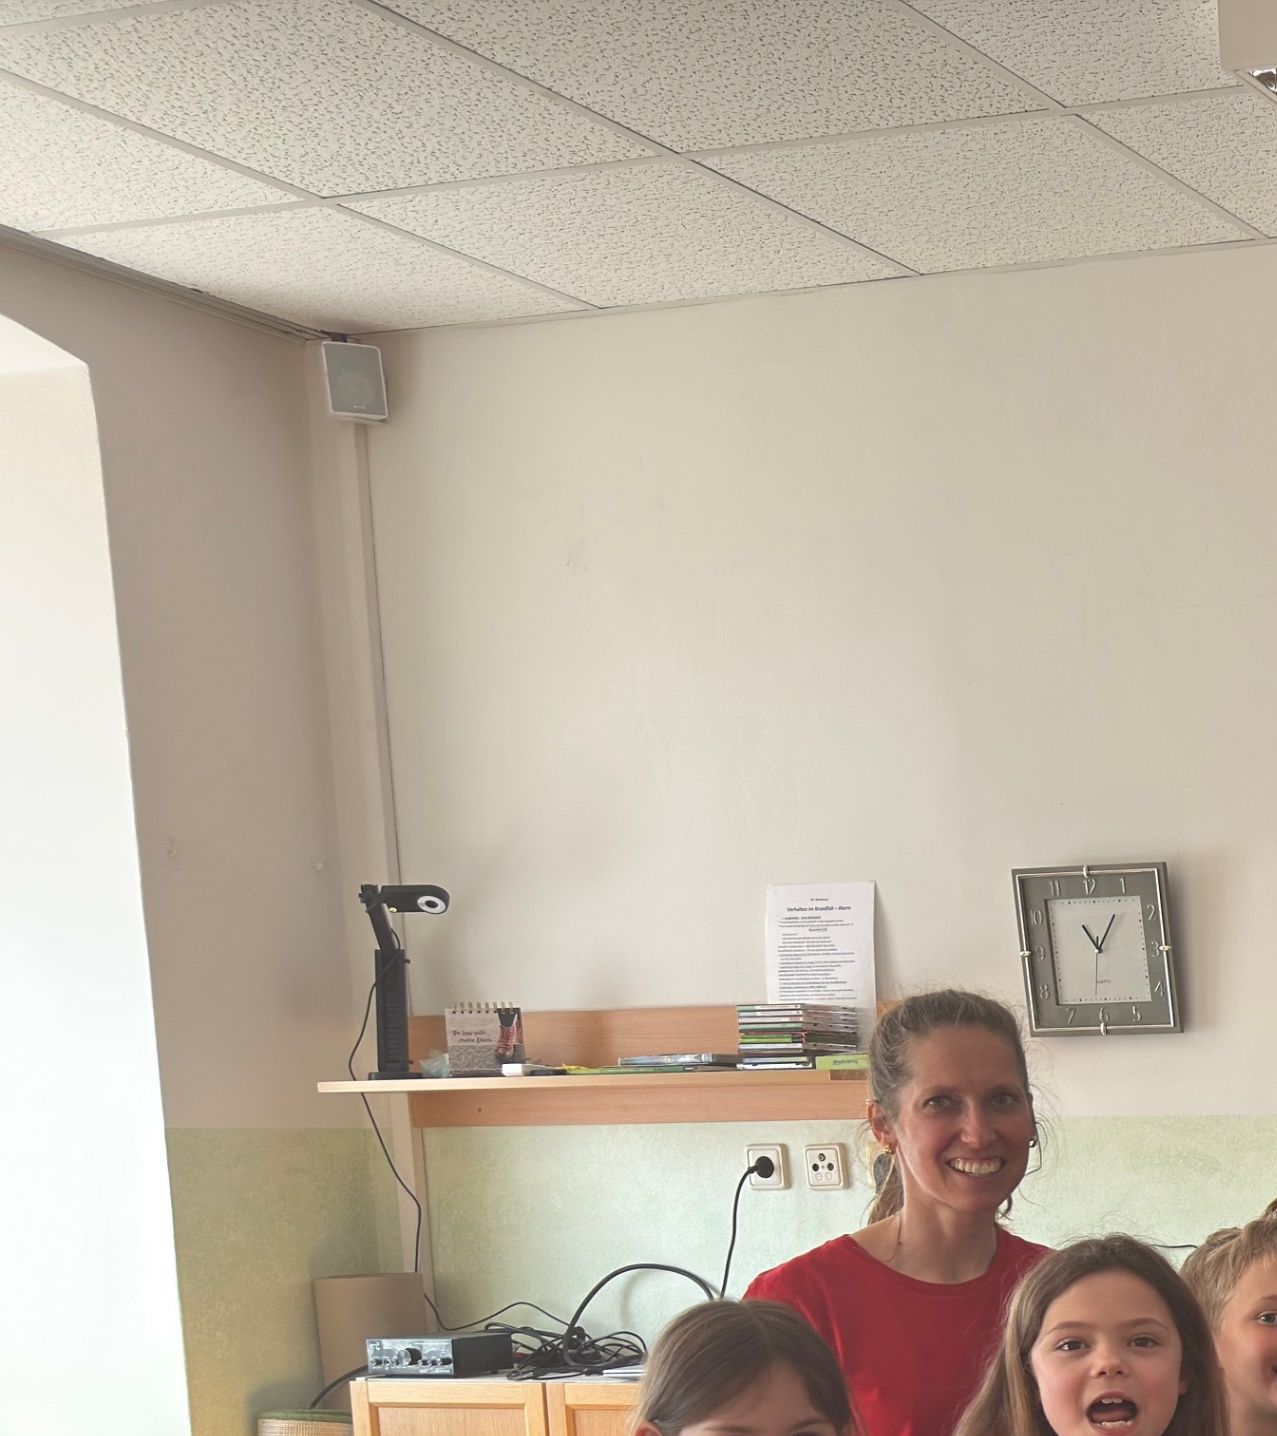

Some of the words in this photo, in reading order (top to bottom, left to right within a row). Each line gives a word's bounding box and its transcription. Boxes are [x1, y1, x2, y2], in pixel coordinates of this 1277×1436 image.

[1083, 878, 1096, 895] 12
[1119, 877, 1126, 894] 1
[1030, 909, 1043, 926] 10
[1039, 984, 1049, 1000] 8
[1154, 979, 1166, 997] 4
[1066, 1007, 1076, 1024] 7
[1132, 1005, 1142, 1021] 5
